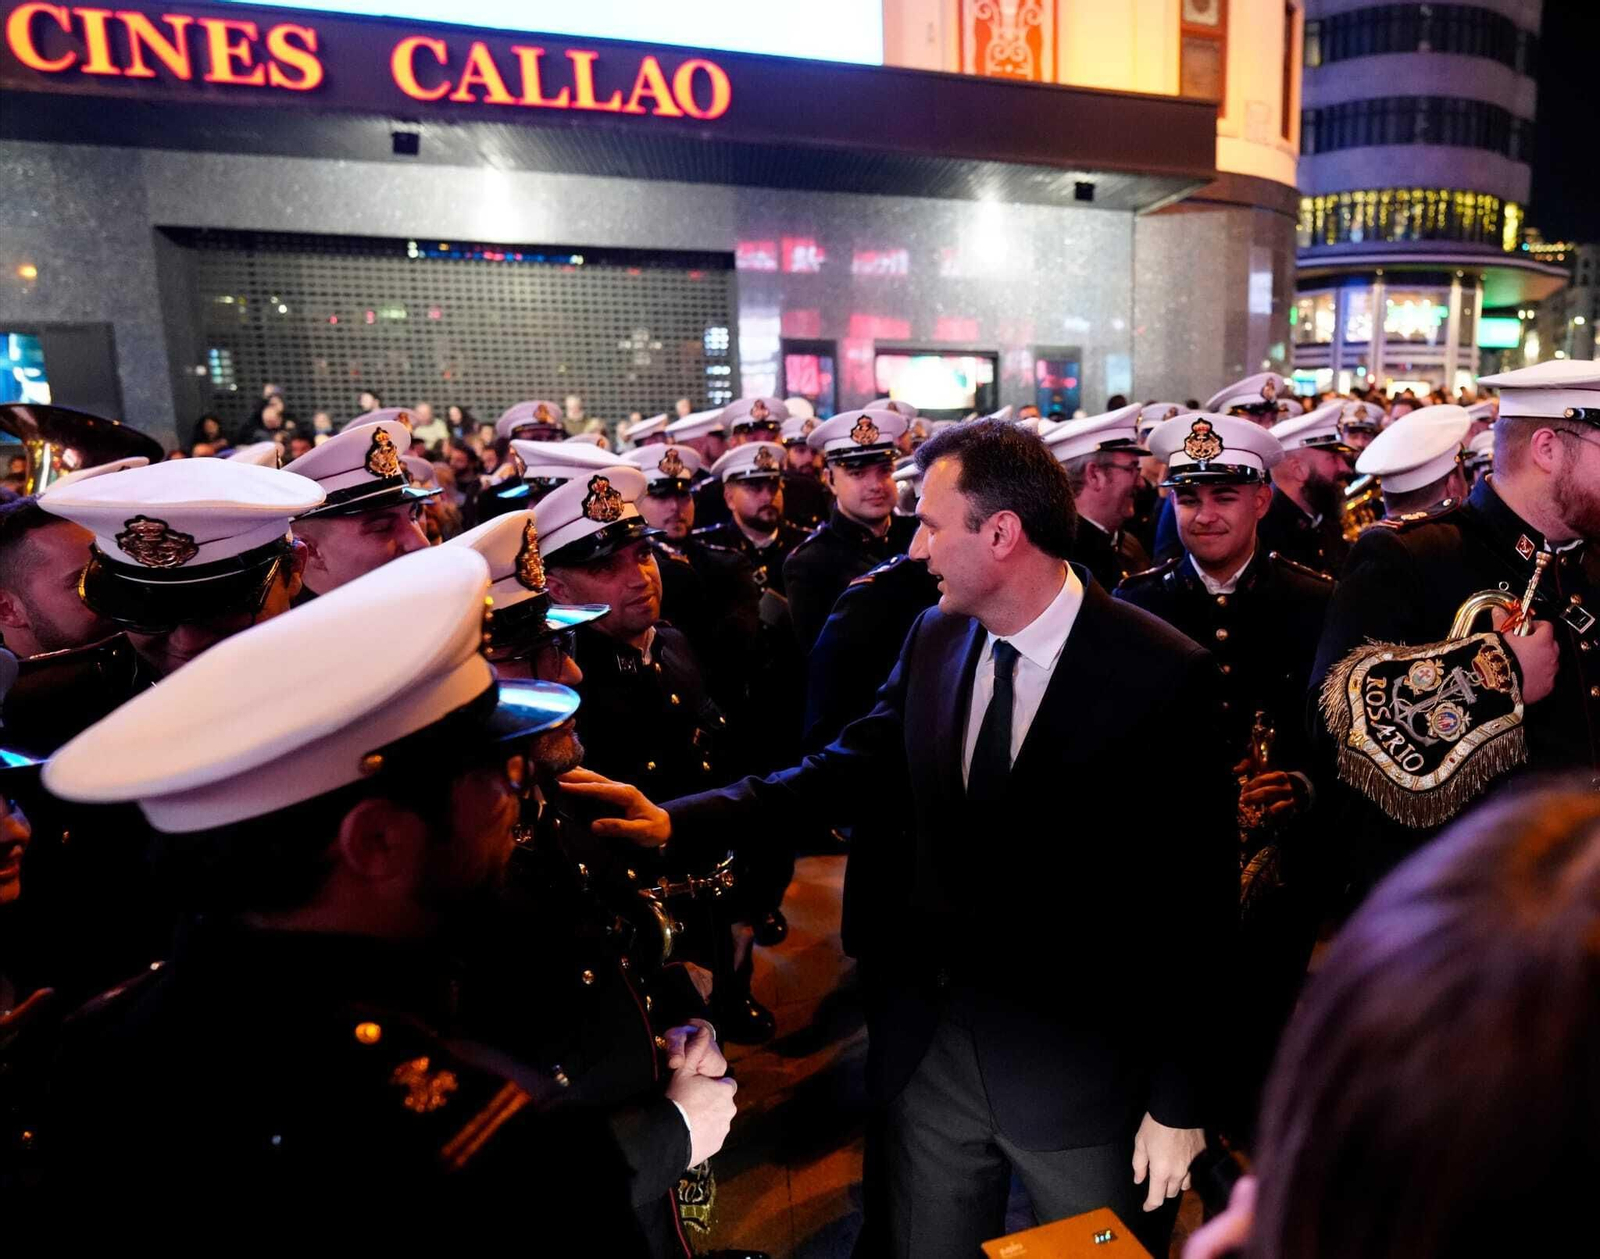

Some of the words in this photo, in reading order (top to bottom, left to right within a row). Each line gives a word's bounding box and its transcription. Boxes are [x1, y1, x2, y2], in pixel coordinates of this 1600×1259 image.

[6, 2, 323, 90] CINES
[390, 36, 731, 119] CALLAO
[1365, 676, 1424, 771] ROSARIO
